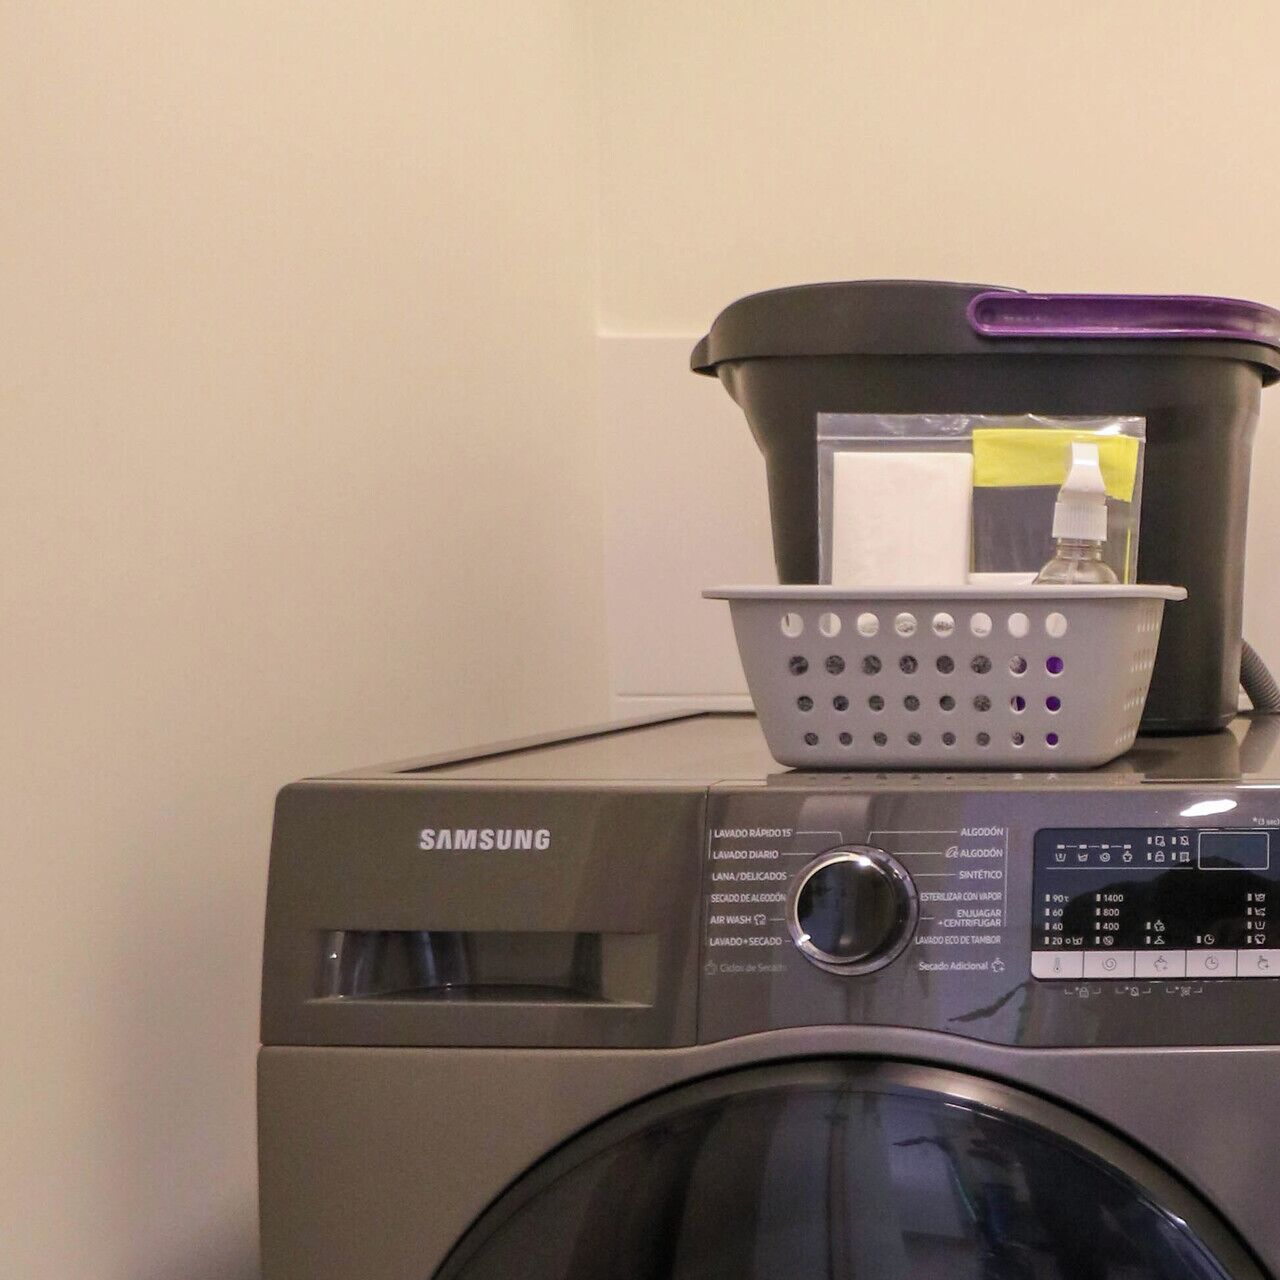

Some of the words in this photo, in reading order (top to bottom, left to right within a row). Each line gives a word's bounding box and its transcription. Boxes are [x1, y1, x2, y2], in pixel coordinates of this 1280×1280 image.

[714, 829, 749, 838] LAVADO
[750, 827, 781, 838] RÁPIDO
[961, 826, 1003, 837] ALGODÓN
[420, 828, 551, 851] SAMSUNG
[713, 850, 748, 860] LAVADO
[749, 850, 779, 859] DIARIO
[960, 847, 1003, 858] ALGODÓN
[712, 872, 787, 881] LANA/DELICADOS
[959, 869, 1003, 879] SINTÉTICO
[711, 893, 740, 903] SECADO
[740, 893, 750, 903] DE
[751, 892, 787, 902] ALGODÓN
[920, 892, 962, 901] ESTERILIZAR
[963, 892, 978, 901] CON
[979, 891, 1002, 901] VAPOR
[1104, 894, 1124, 902] 1400
[957, 909, 1002, 918] ENJUAGAR
[1052, 908, 1063, 917] 60
[1102, 908, 1120, 917] 800
[710, 915, 727, 924] AIR
[727, 915, 751, 924] WASH
[1052, 922, 1063, 931] 40
[1102, 922, 1120, 931] 400
[915, 936, 944, 945] LAVADO
[945, 936, 960, 945] ECO
[960, 936, 970, 945] DE
[971, 935, 1002, 944] TAMBOR
[1052, 937, 1063, 945] 20
[919, 961, 949, 971] Secado
[950, 961, 989, 971] Adicional
